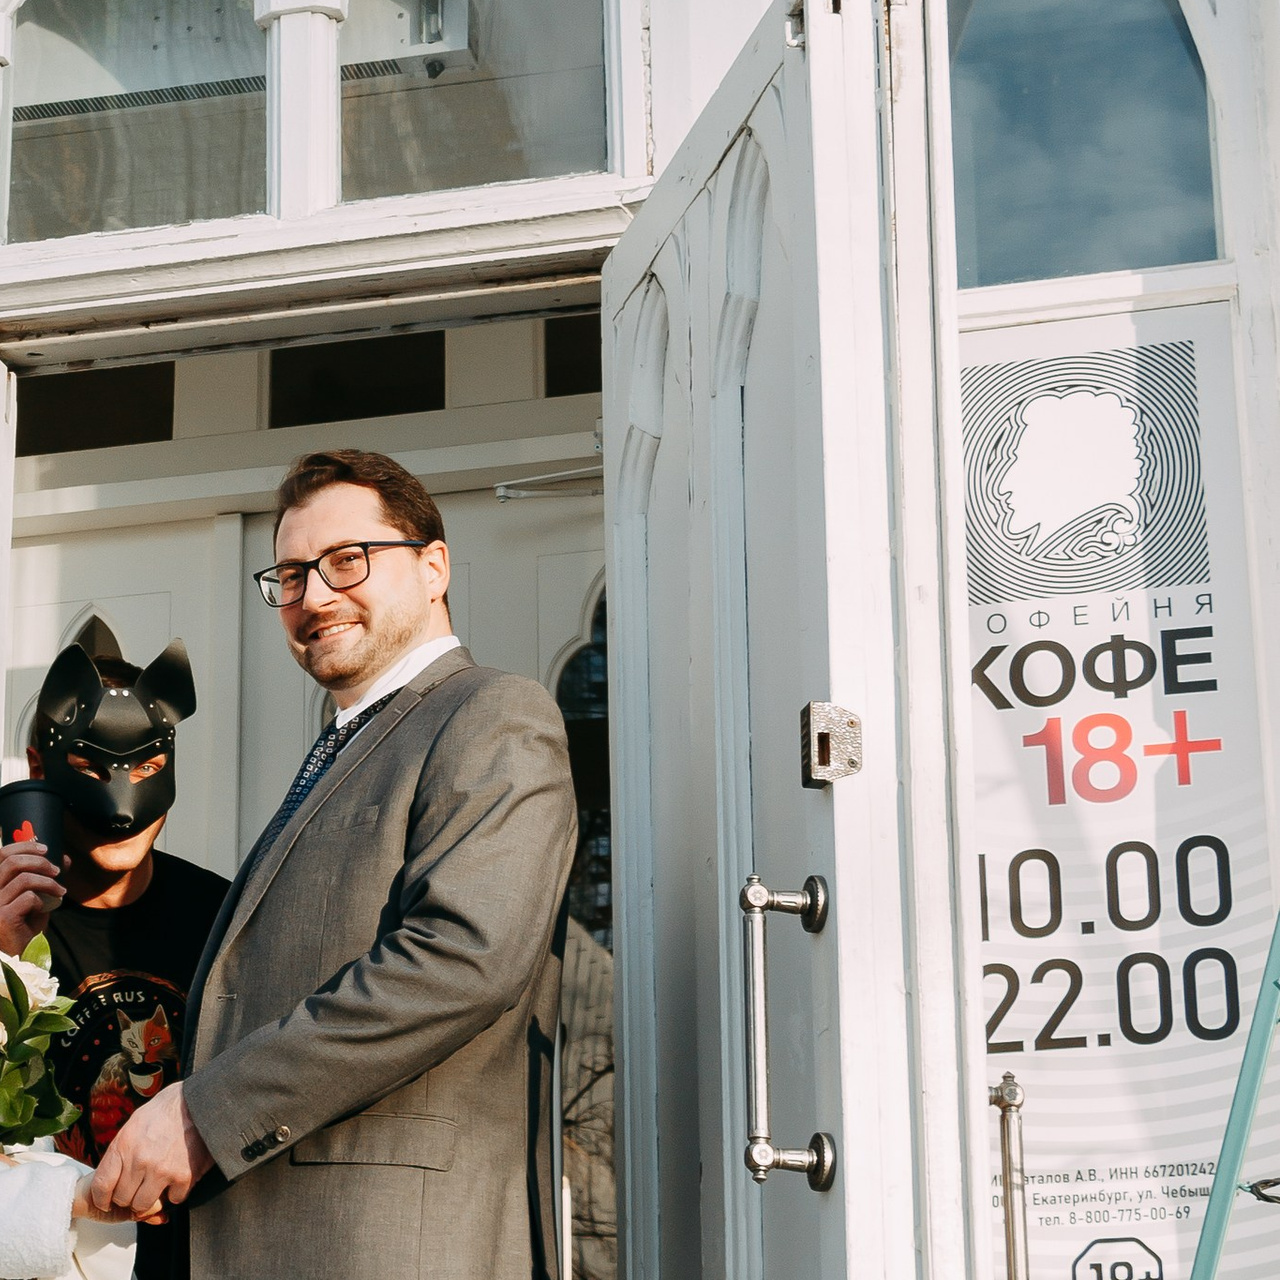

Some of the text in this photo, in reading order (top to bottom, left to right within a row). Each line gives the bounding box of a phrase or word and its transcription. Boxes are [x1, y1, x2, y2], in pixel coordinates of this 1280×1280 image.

[986, 593, 1214, 634] ОФЕЙНЯ
[971, 625, 1218, 710] КОФЕ
[1022, 710, 1222, 805] 18+
[982, 947, 1240, 1054] 22.00
[1024, 1173, 1070, 1185] аталов
[1109, 1167, 1138, 1180] ИНН
[1143, 1162, 1216, 1179] 667201242
[1032, 1189, 1133, 1207] Екатеринбург,
[1161, 1185, 1210, 1199] Чебыш
[1039, 1205, 1190, 1226] тел. 8-800-775-00-69
